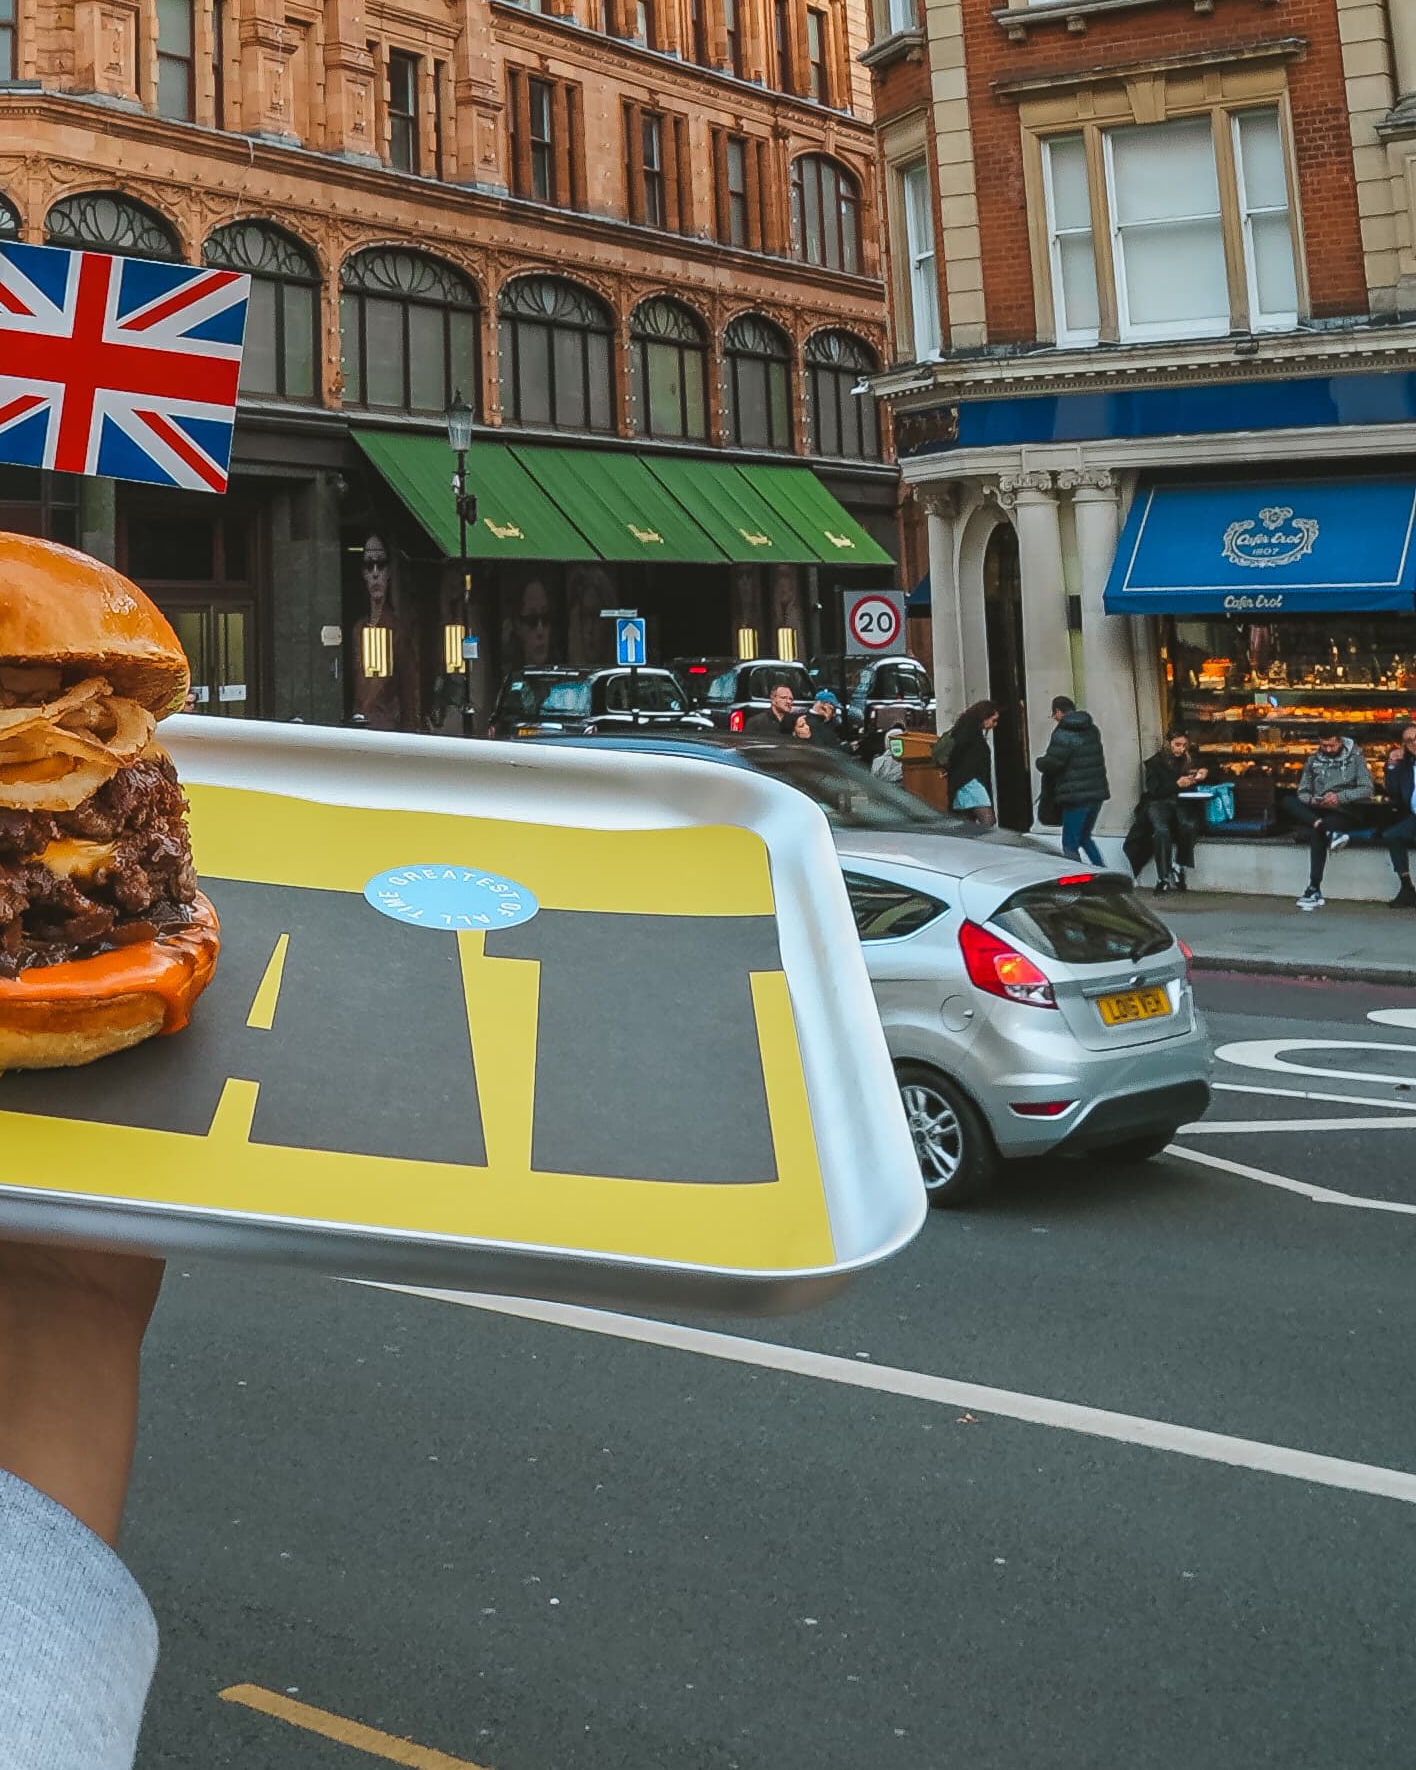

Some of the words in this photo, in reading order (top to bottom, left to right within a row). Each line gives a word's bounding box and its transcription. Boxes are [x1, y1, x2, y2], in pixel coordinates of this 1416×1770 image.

[858, 611, 893, 633] 20
[388, 869, 521, 900] GREATEST
[378, 890, 425, 920] TIME
[497, 901, 522, 918] OF
[440, 912, 492, 926] ALL
